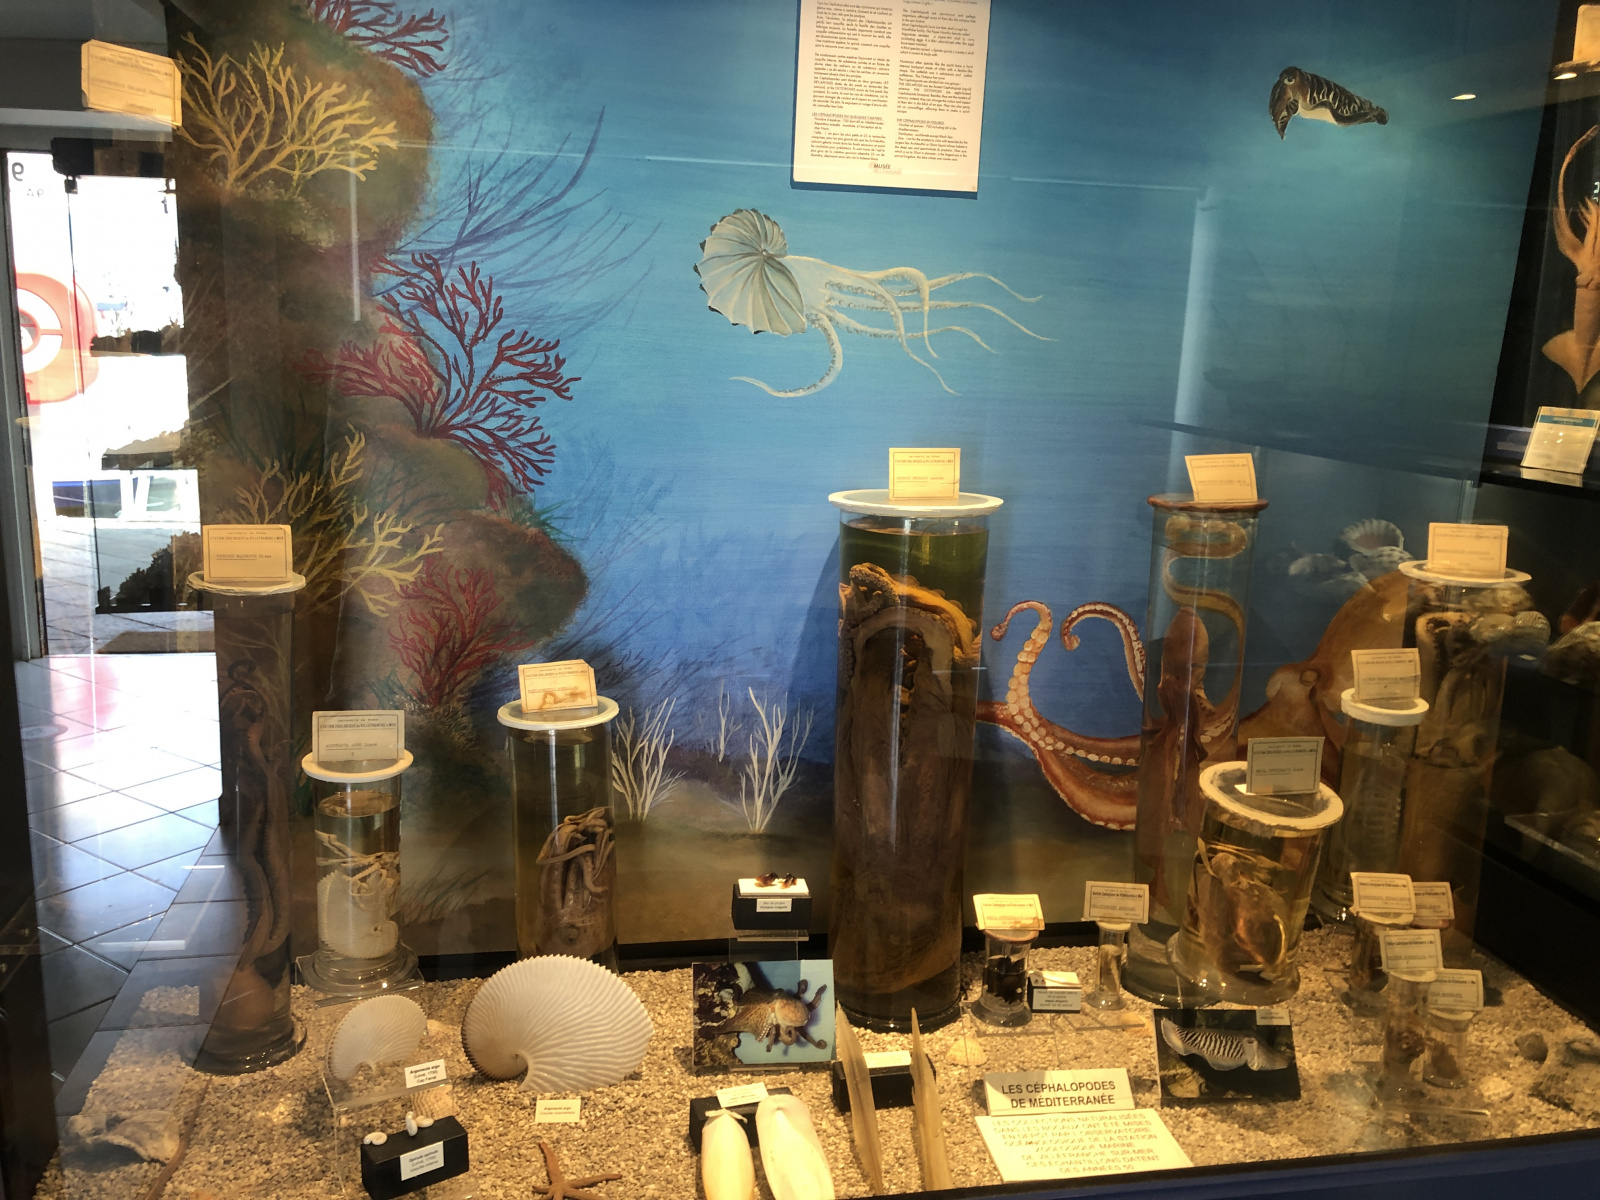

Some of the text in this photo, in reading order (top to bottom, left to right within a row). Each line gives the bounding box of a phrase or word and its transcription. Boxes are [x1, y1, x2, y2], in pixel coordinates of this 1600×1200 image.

[1001, 1080, 1116, 1095] LES CÉPHALOPODES
[1010, 1092, 1116, 1109] DE MÉDITERRANÉE
[1076, 1113, 1146, 1122] NATURALISÉES
[1123, 1119, 1152, 1127] MISES
[1123, 1155, 1160, 1163] DATENT
